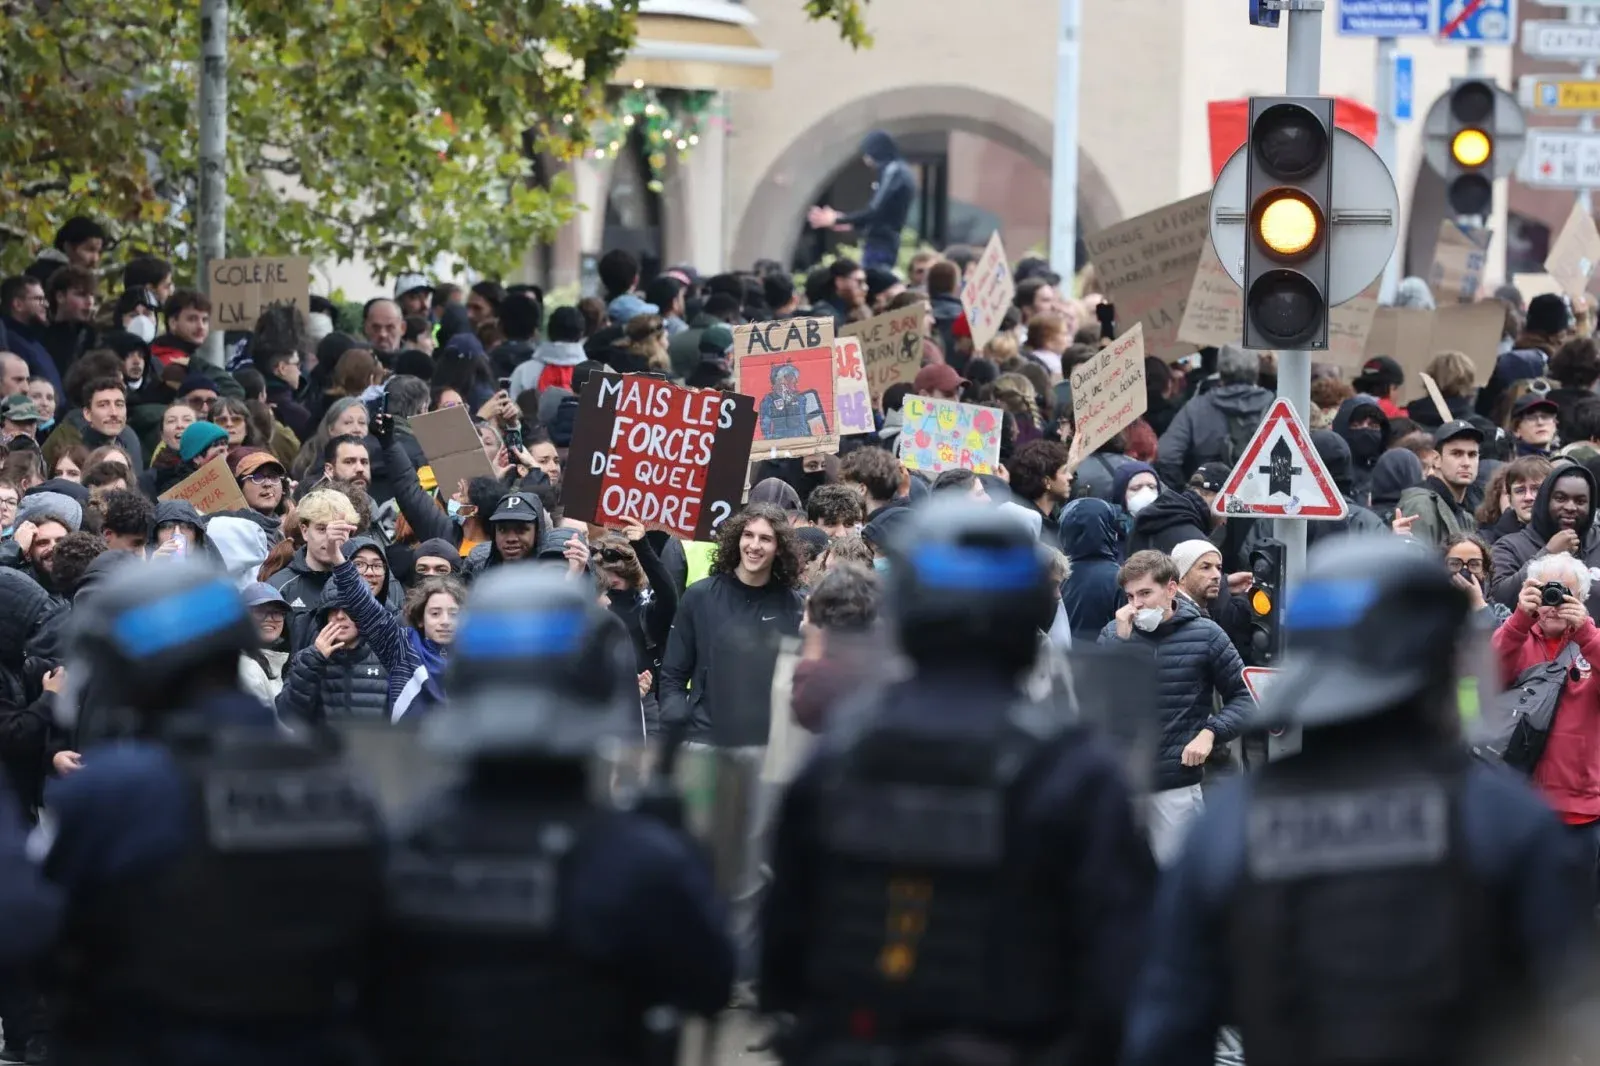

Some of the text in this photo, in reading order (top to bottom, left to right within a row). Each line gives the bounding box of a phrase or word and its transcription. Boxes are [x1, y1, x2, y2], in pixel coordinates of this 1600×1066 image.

[747, 319, 822, 354] ACAB
[597, 377, 736, 429] MAIS LES
[610, 416, 715, 466] FORCES
[590, 451, 702, 492] DE QUEL
[192, 488, 225, 512] UTUR
[507, 496, 521, 509] P
[602, 484, 732, 537] ORDRE ?
